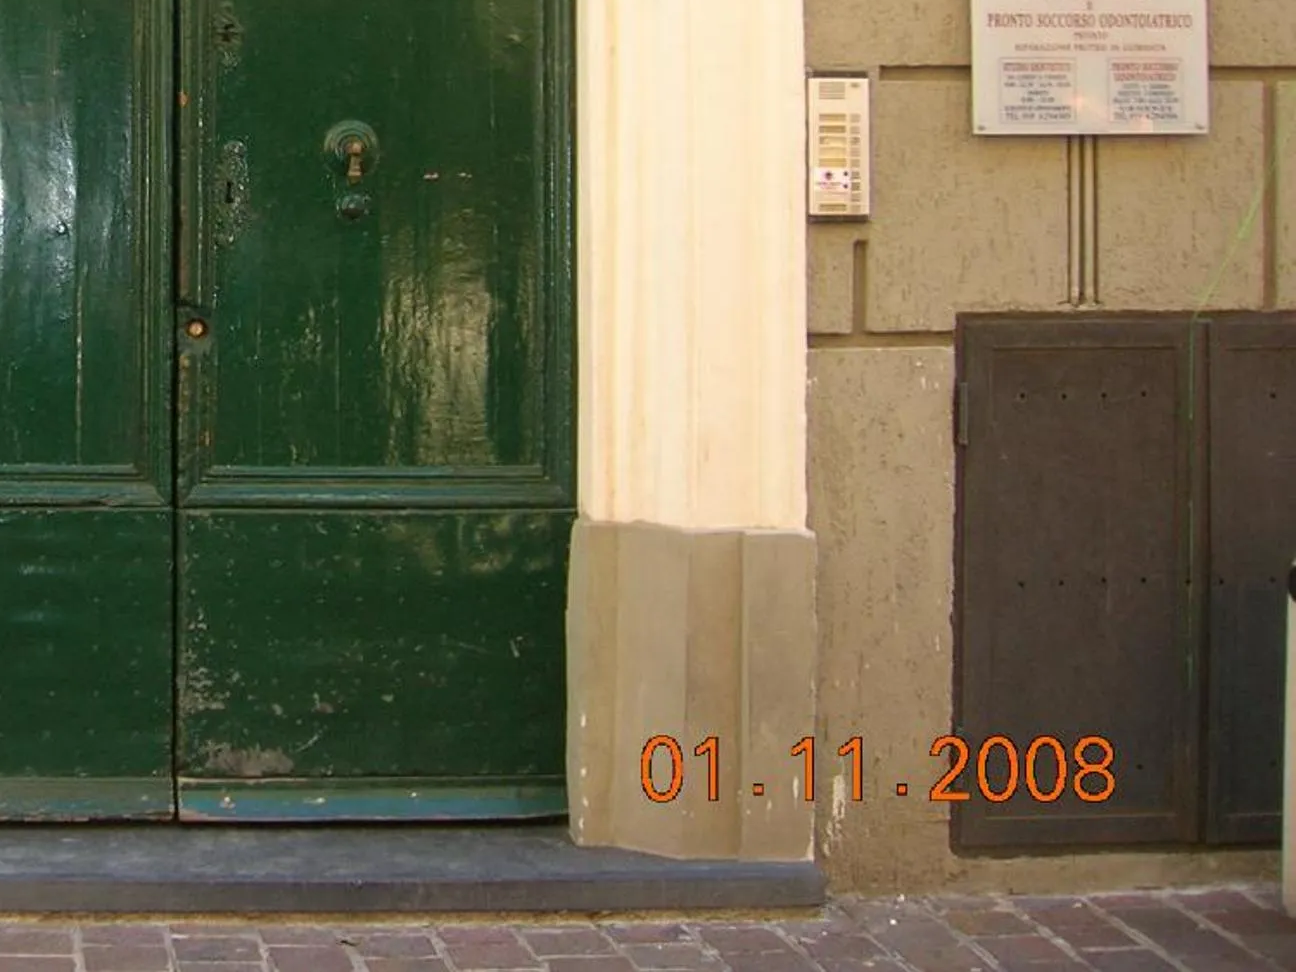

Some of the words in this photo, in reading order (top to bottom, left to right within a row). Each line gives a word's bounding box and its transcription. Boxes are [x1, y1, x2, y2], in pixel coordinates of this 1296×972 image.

[987, 13, 1033, 28] PRONTO
[1036, 13, 1096, 28] SOCCORSO
[1099, 13, 1193, 28] ODONTOIATRICO
